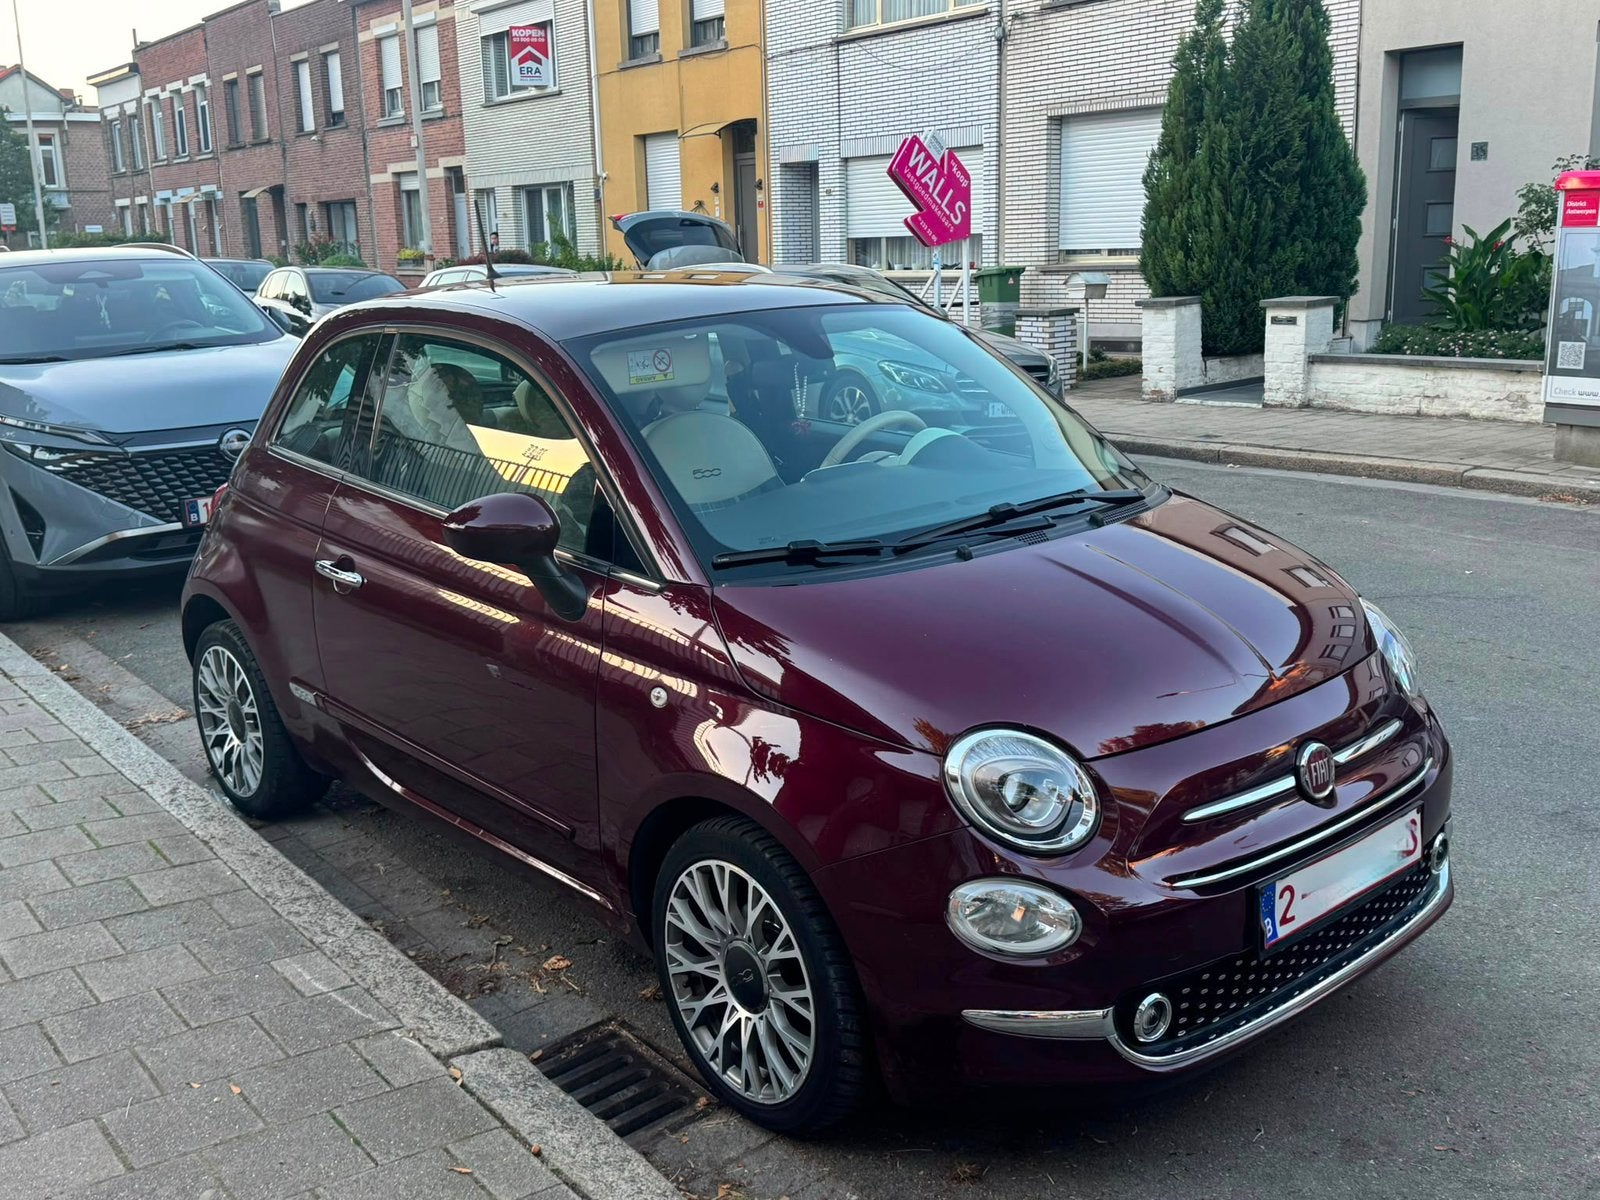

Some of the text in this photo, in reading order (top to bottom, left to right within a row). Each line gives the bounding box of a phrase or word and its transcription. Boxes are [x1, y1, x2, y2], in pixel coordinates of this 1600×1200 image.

[511, 29, 545, 37] KOPEN
[520, 66, 541, 75] ERA
[908, 143, 966, 225] WALLS
[952, 164, 969, 187] koop
[904, 165, 955, 232] Vastgoedmakelaars
[692, 468, 722, 480] 500
[1310, 757, 1330, 787] FIAT
[1264, 917, 1273, 939] B
